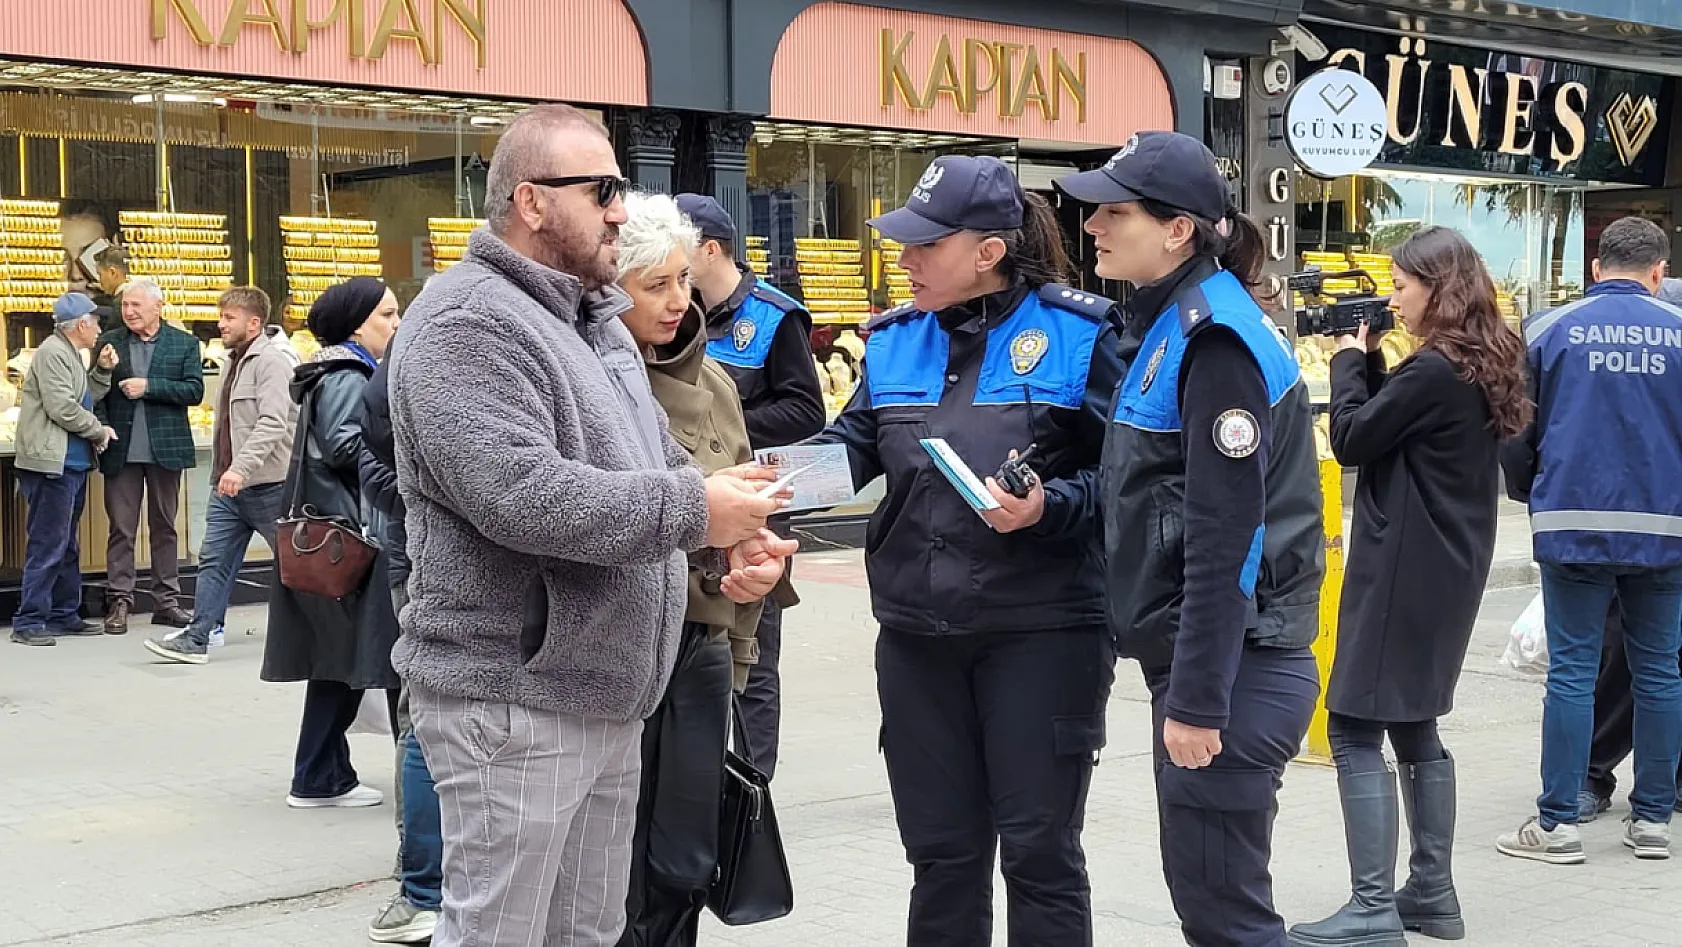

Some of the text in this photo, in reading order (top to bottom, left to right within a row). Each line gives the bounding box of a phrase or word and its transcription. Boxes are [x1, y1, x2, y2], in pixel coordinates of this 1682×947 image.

[880, 28, 1087, 125] KAPTAN
[1292, 119, 1383, 144] GÜNEŞ
[1302, 147, 1372, 156] KUYUMCULUK
[1568, 325, 1682, 348] SAMSUN
[1589, 348, 1666, 375] POLİS
